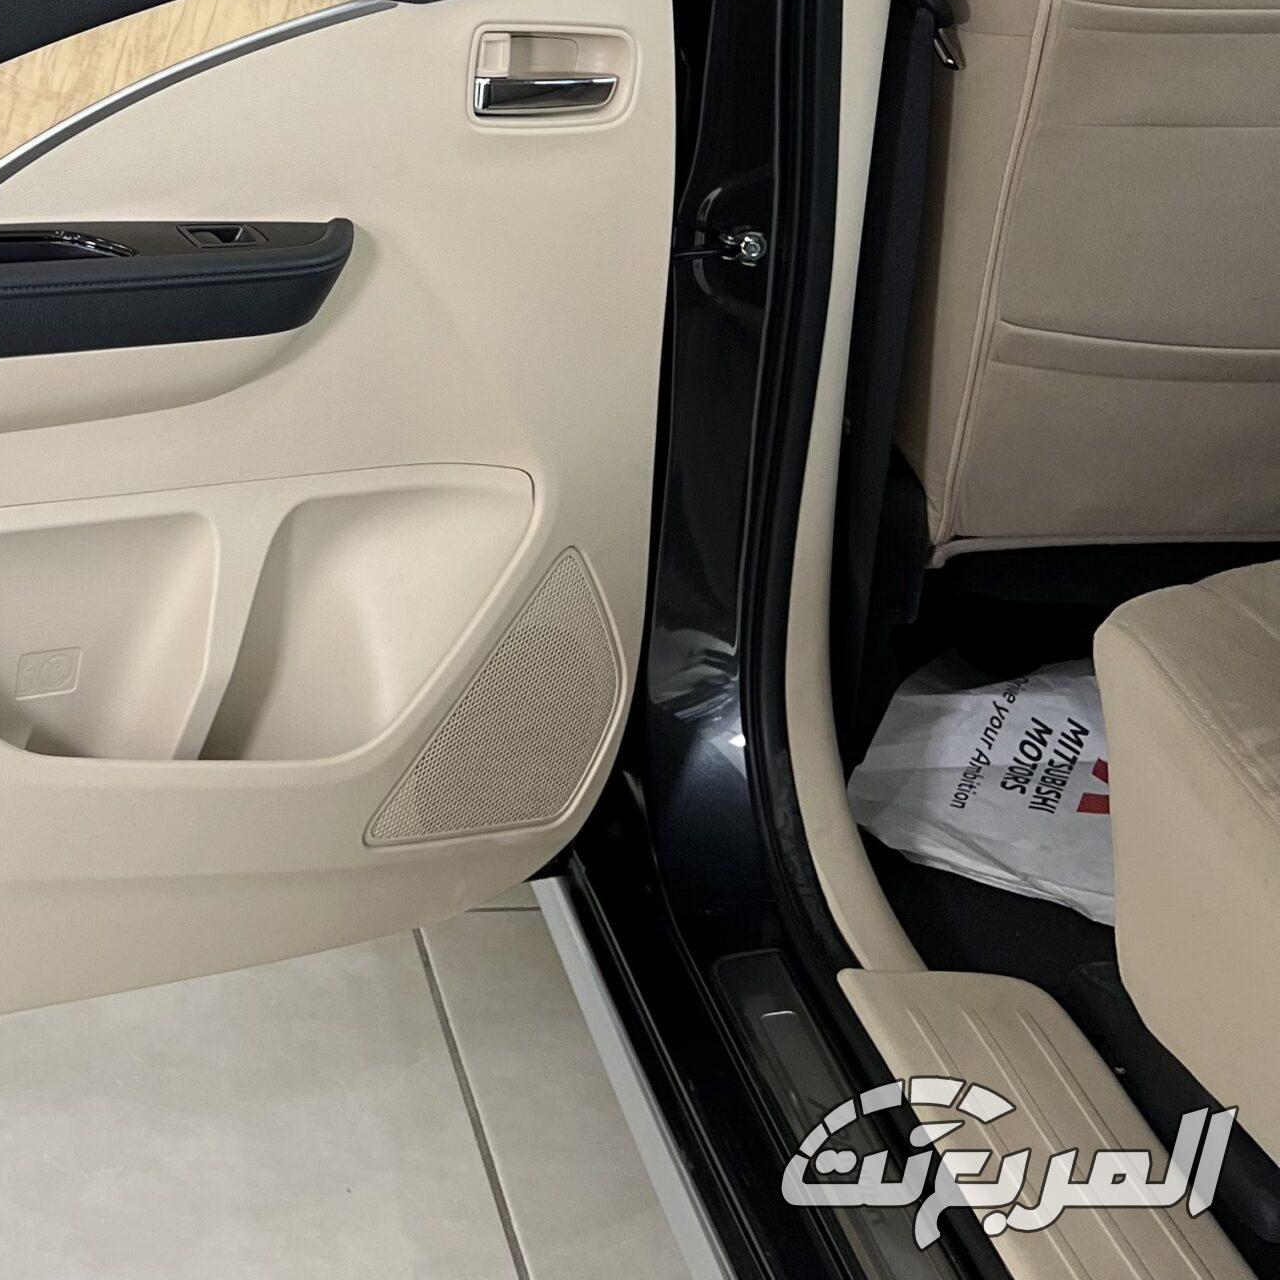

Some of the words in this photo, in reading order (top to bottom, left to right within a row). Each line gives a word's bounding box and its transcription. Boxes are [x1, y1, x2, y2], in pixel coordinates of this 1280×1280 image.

[980, 700, 1010, 751] your
[1000, 716, 1054, 795] MOTORS
[949, 747, 991, 809] Ambition
[1028, 717, 1090, 814] MITSUBISHI
